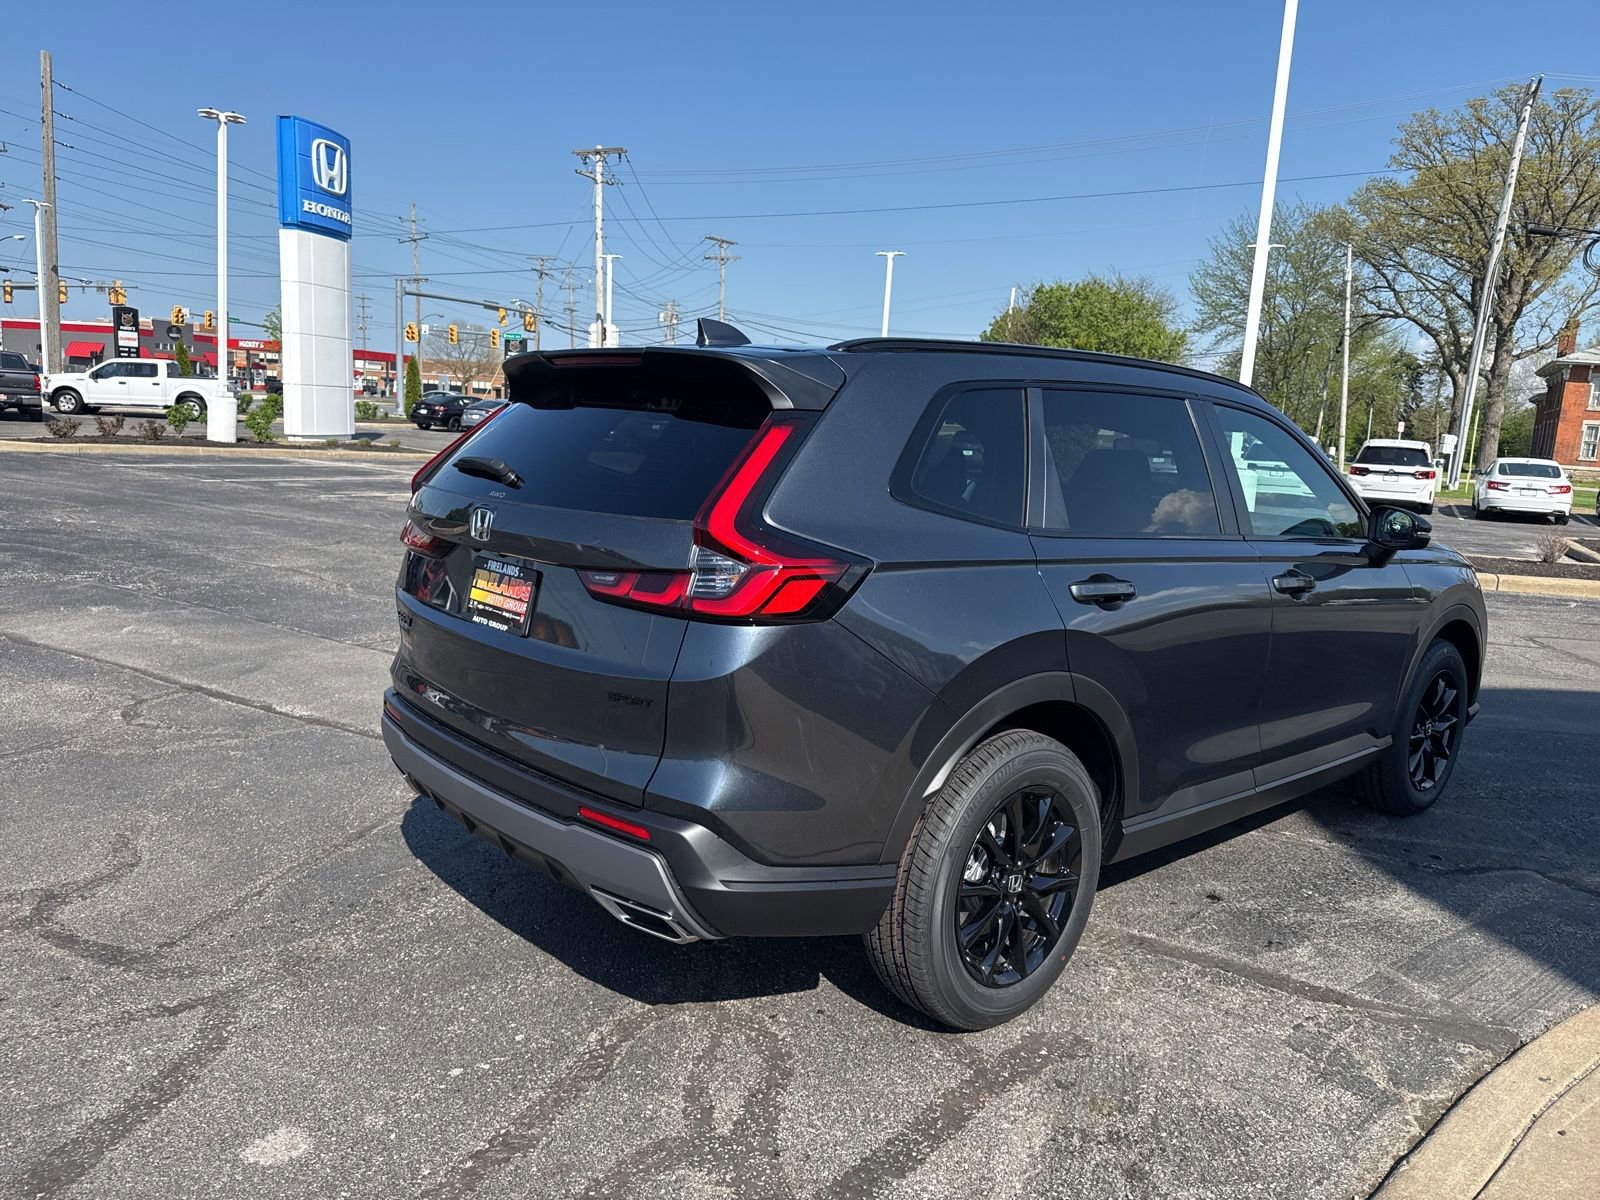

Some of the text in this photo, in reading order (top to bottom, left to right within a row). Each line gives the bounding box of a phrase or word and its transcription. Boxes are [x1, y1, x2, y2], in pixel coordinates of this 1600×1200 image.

[302, 199, 351, 224] HONDA
[486, 560, 520, 577] FIRELANDS
[472, 615, 509, 632] AUTO GROUP
